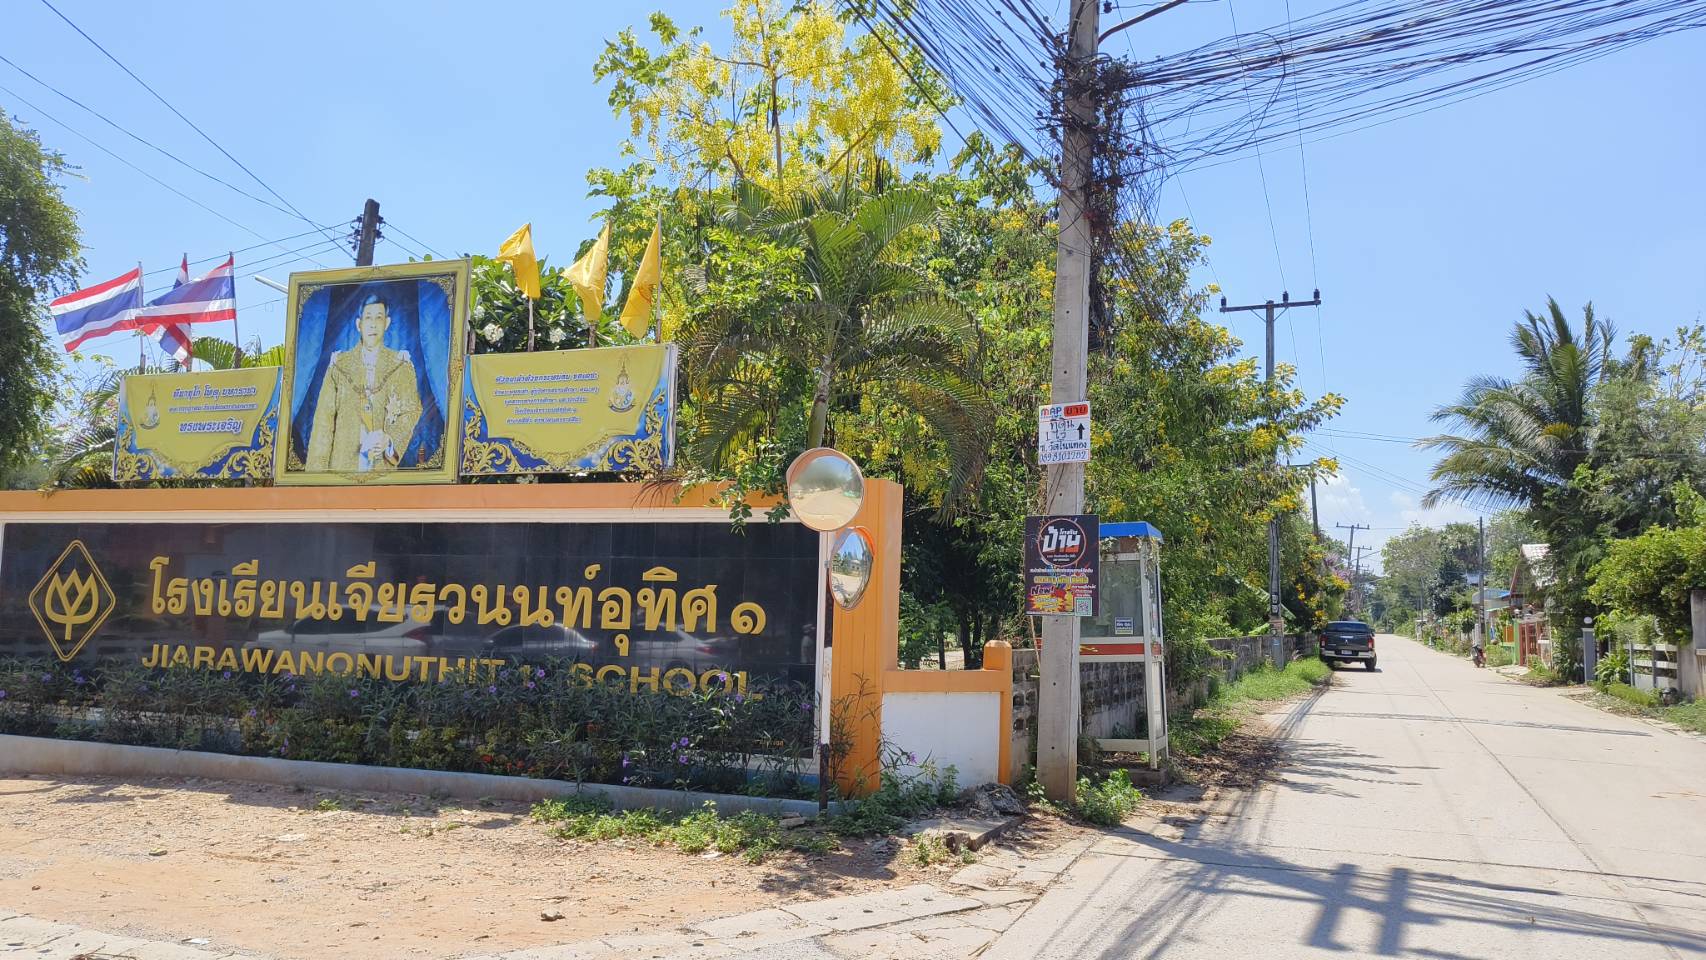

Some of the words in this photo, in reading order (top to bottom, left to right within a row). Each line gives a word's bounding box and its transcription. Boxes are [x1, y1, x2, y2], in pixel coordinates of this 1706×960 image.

[149, 556, 718, 657] โรงเรียนเจียรวนนท์อุทิศ
[730, 601, 767, 635] ๑
[566, 663, 764, 700] SCHOOL
